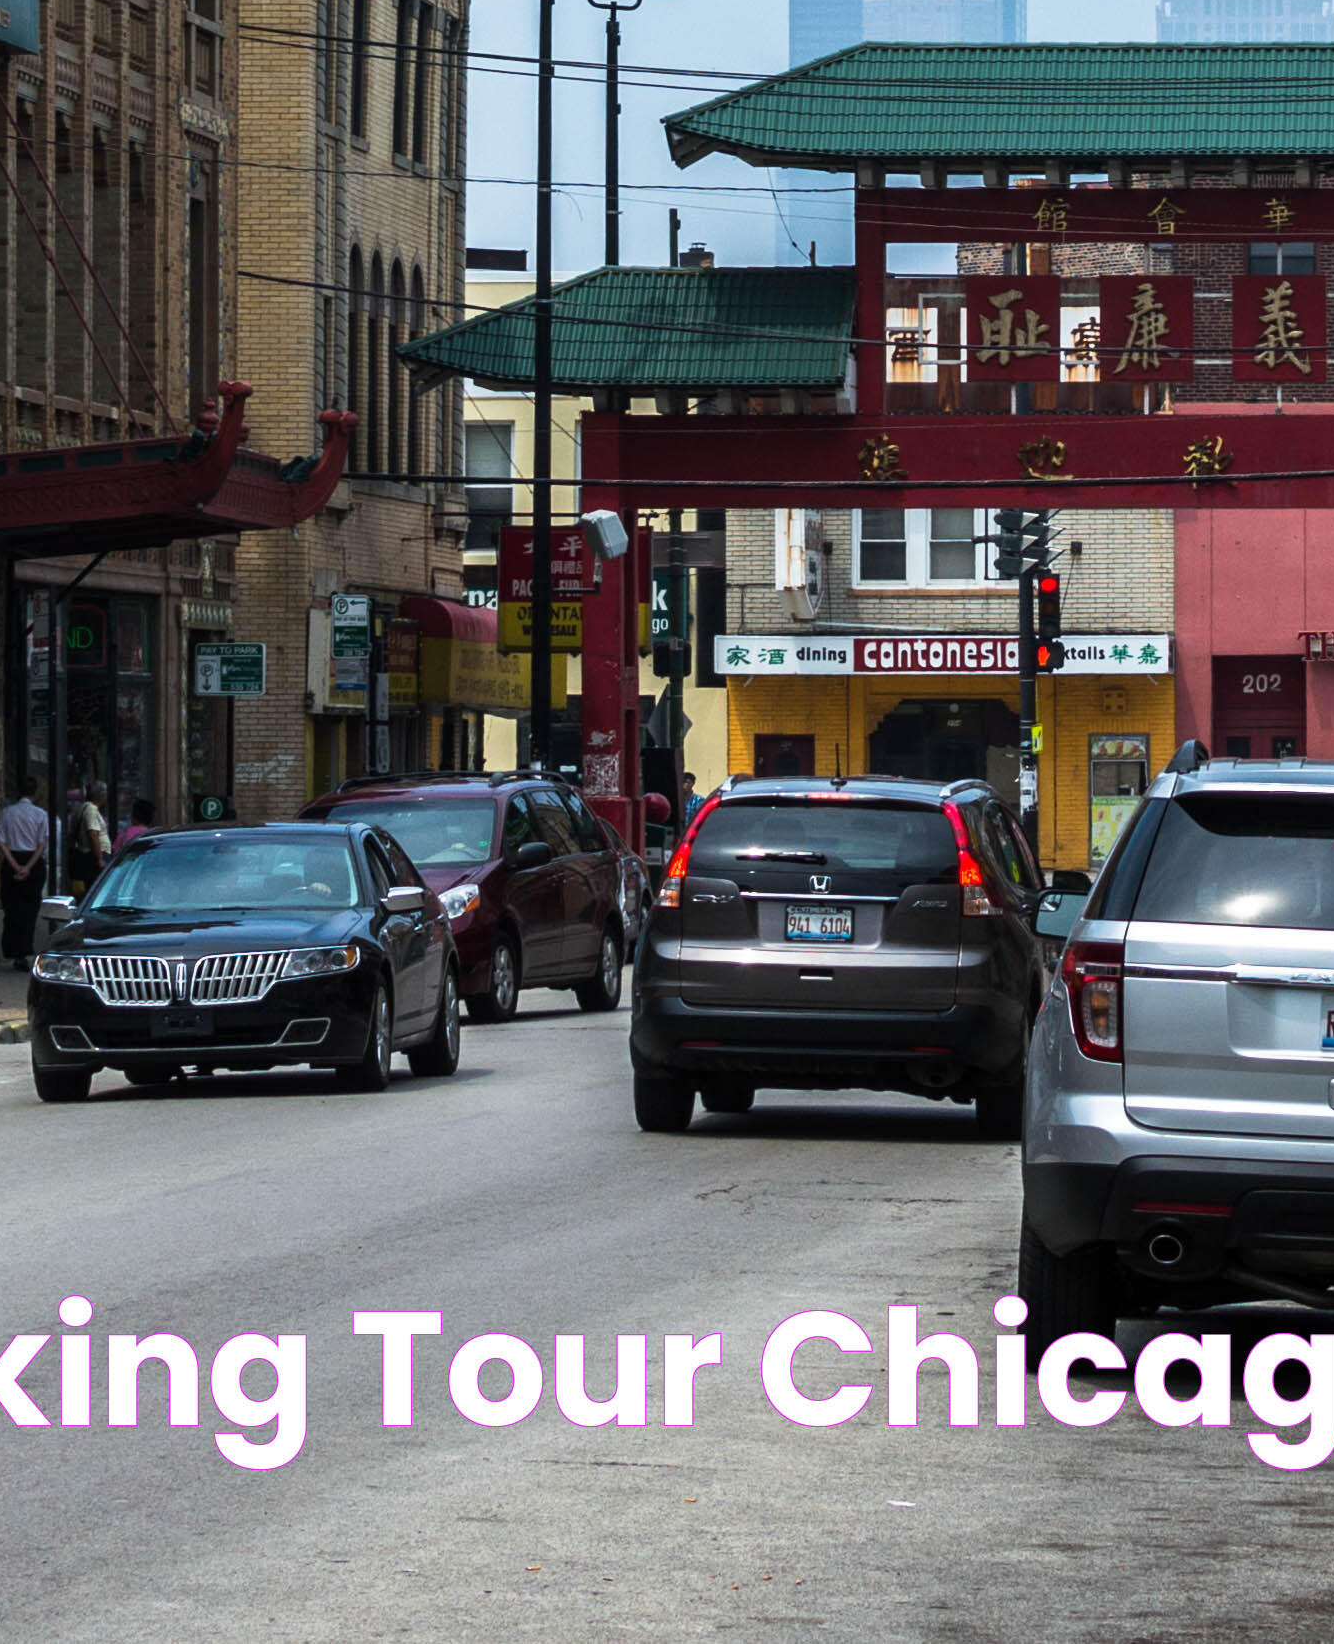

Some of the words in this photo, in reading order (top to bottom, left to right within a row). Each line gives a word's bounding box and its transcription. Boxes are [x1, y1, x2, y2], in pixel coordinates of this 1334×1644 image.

[796, 646, 848, 664] dining
[1242, 673, 1282, 695] 202
[788, 916, 812, 934] 941
[820, 916, 850, 935] 6104
